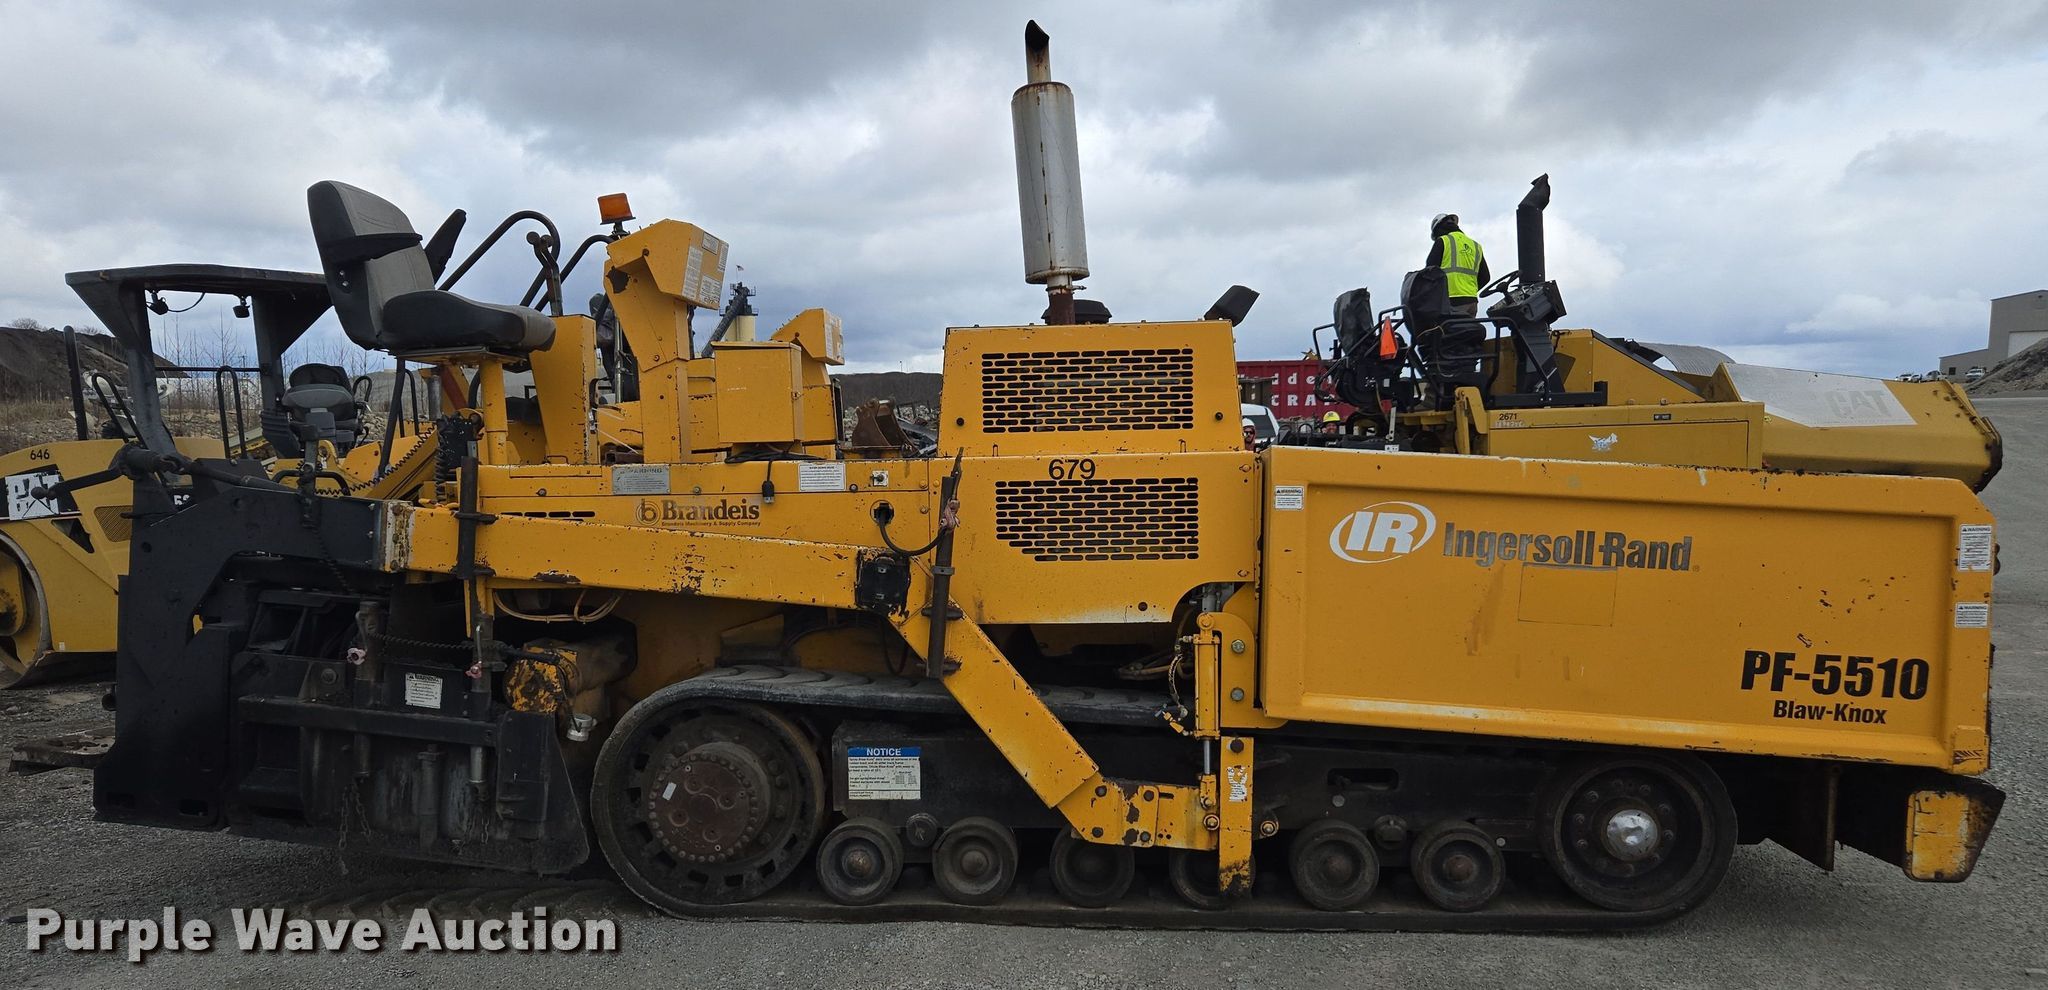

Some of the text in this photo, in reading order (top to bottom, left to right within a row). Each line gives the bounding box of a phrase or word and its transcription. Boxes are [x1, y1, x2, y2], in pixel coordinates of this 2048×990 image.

[1826, 390, 1893, 419] CAT
[1499, 413, 1518, 421] 2671
[30, 449, 50, 460] 646
[1048, 458, 1096, 480] 679
[661, 498, 760, 521] Brandeis
[1345, 511, 1418, 554] IR
[1443, 522, 1693, 572] Ingersoll-Rand
[1741, 650, 1930, 701] PF-5510
[1773, 700, 1887, 724] Blaw-Knox
[866, 747, 902, 756] NOTICE
